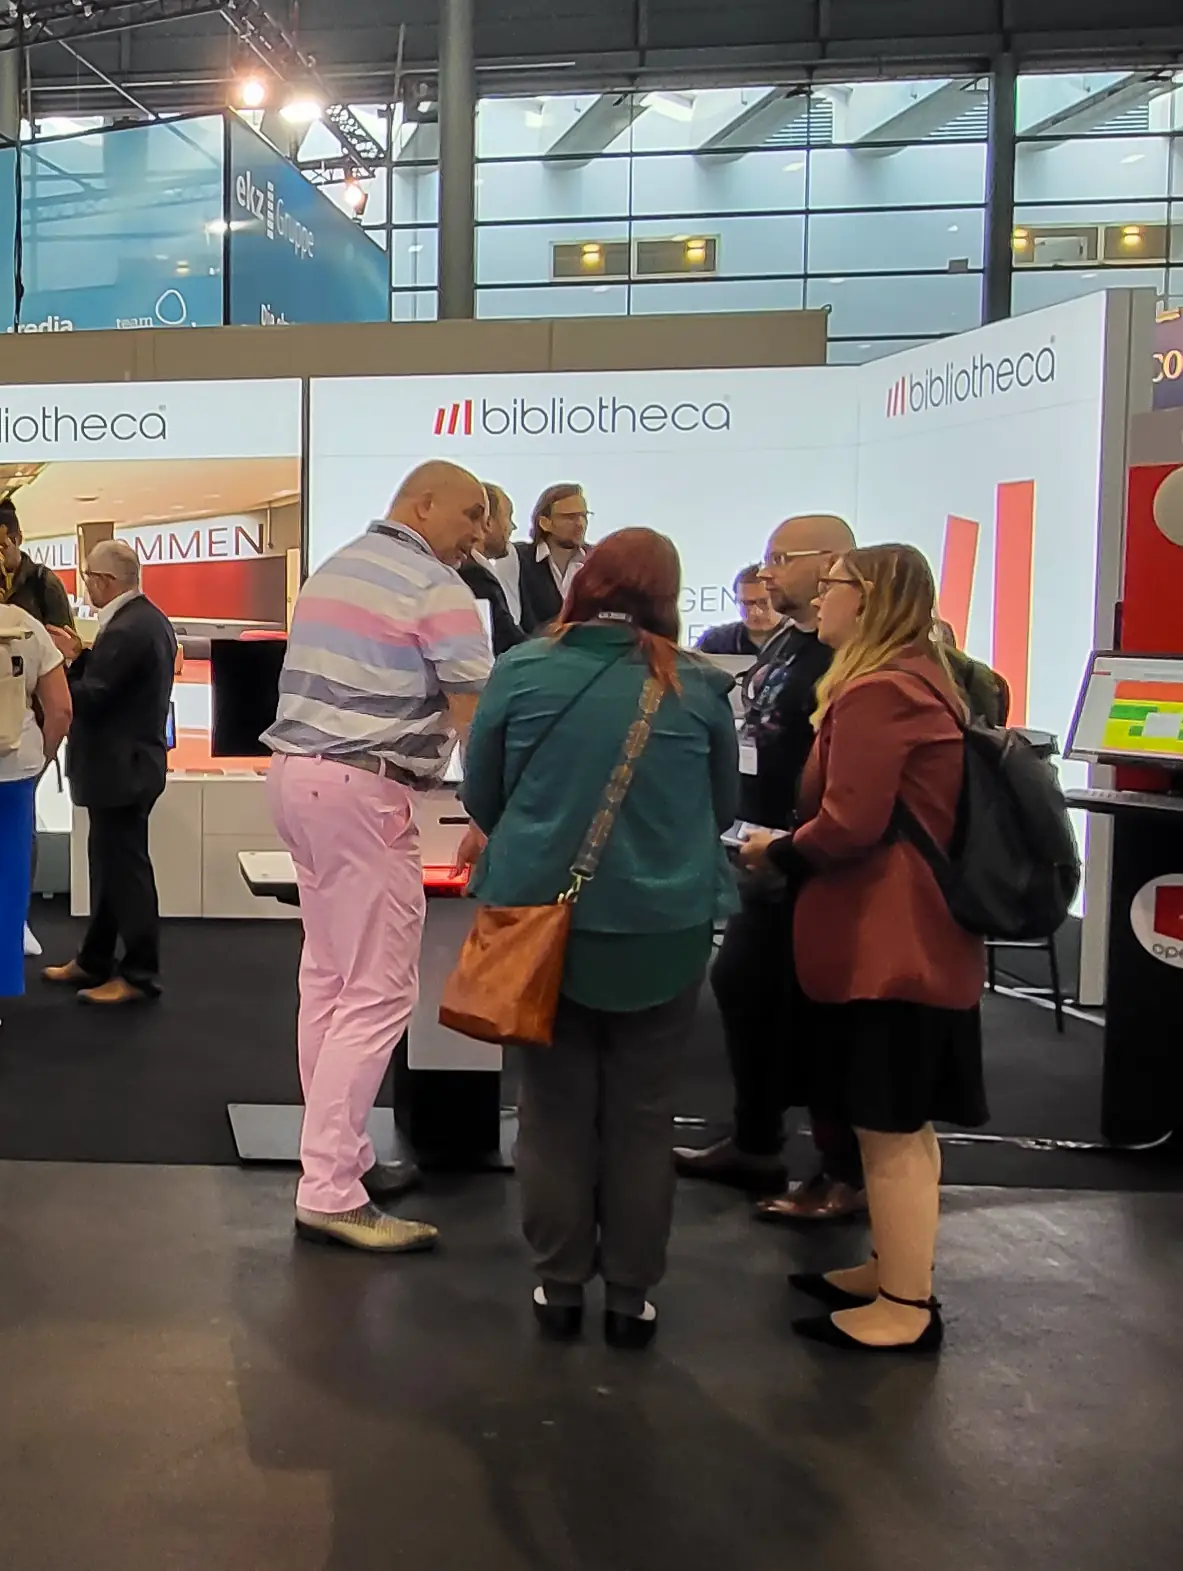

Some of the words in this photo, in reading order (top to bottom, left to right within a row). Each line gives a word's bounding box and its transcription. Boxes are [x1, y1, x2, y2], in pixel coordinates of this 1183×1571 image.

[236, 170, 265, 221] ekz
[276, 198, 315, 260] Gruppe
[909, 347, 1055, 412] bibliotheca
[481, 396, 731, 435] bibliotheca
